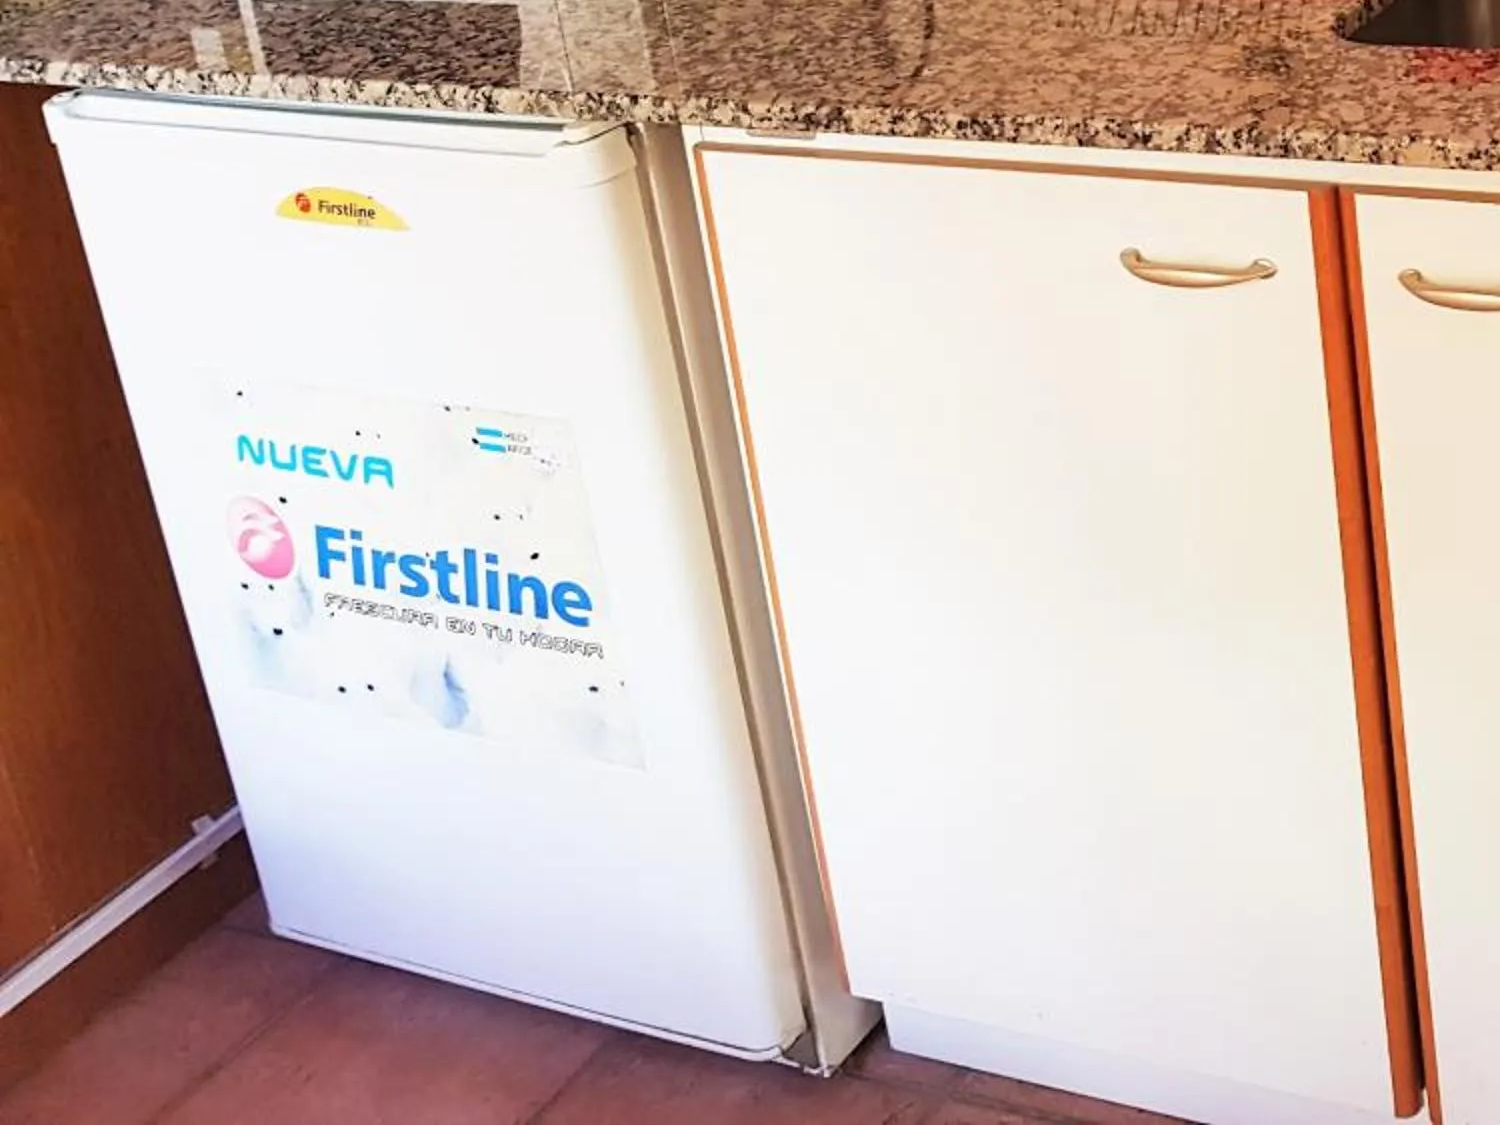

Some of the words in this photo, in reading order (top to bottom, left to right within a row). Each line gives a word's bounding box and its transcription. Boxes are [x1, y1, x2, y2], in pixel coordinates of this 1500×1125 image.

[317, 199, 376, 220] Firstline
[236, 433, 395, 489] NUEVA
[314, 524, 594, 628] Firstline
[445, 616, 476, 637] EN
[482, 621, 512, 644] TU
